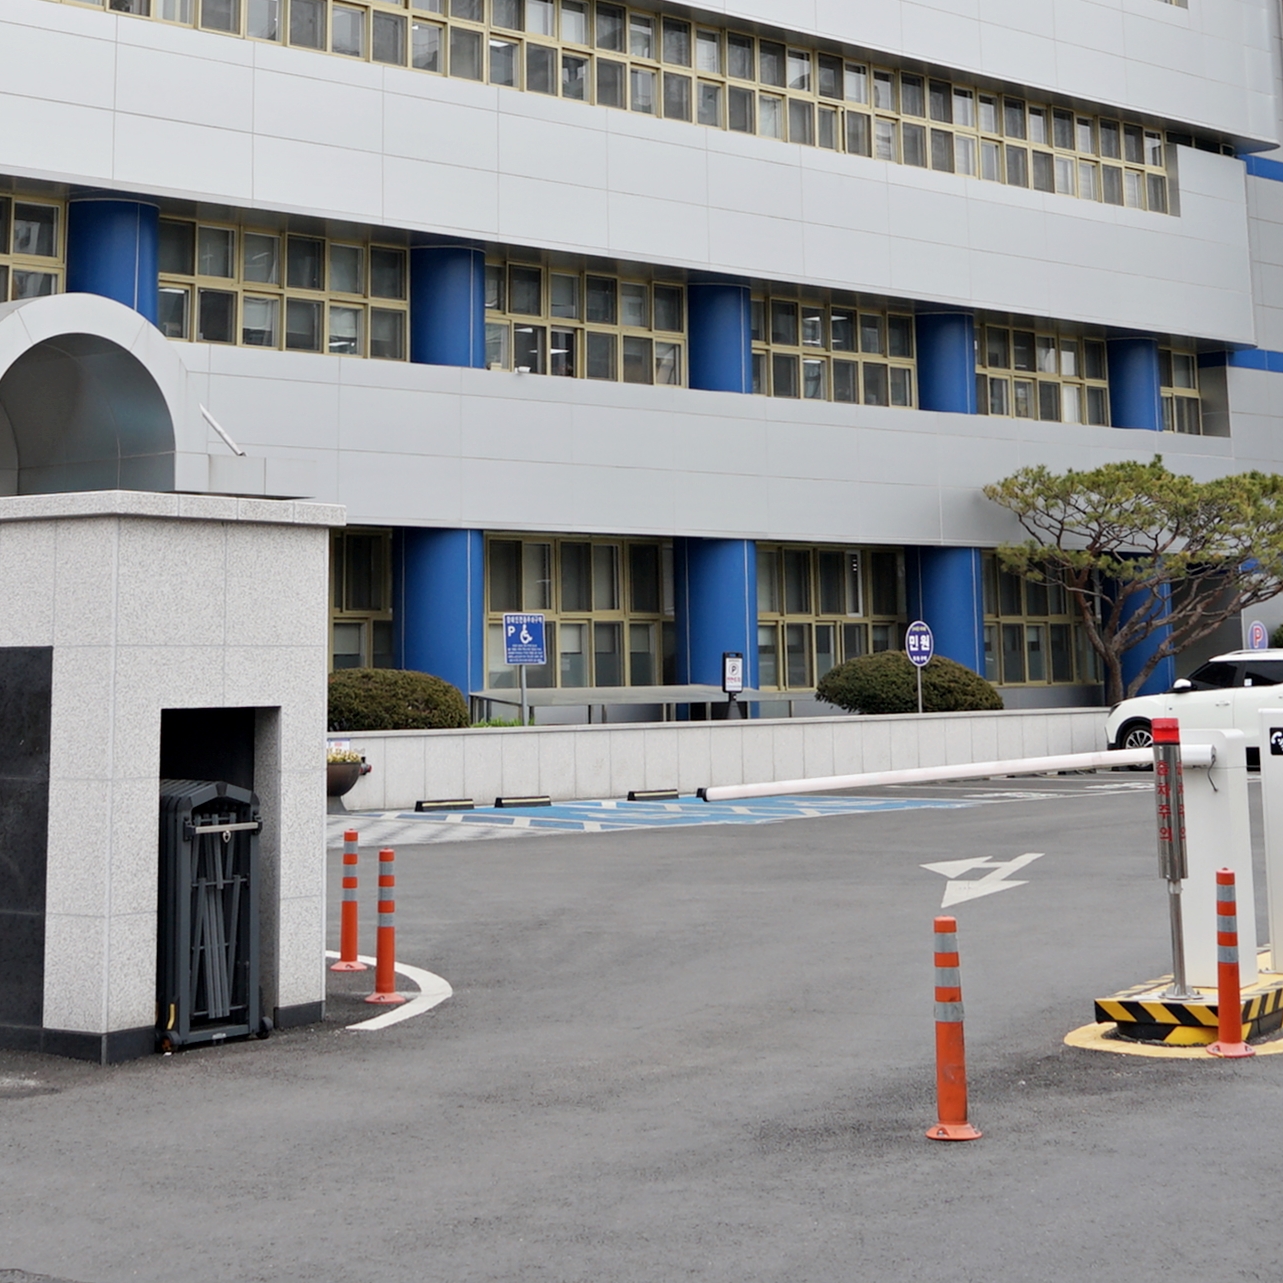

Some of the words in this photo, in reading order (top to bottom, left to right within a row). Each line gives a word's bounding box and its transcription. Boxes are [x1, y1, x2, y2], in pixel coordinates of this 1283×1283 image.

[507, 625, 516, 637] P
[1252, 625, 1264, 649] P
[909, 634, 931, 652] 민원
